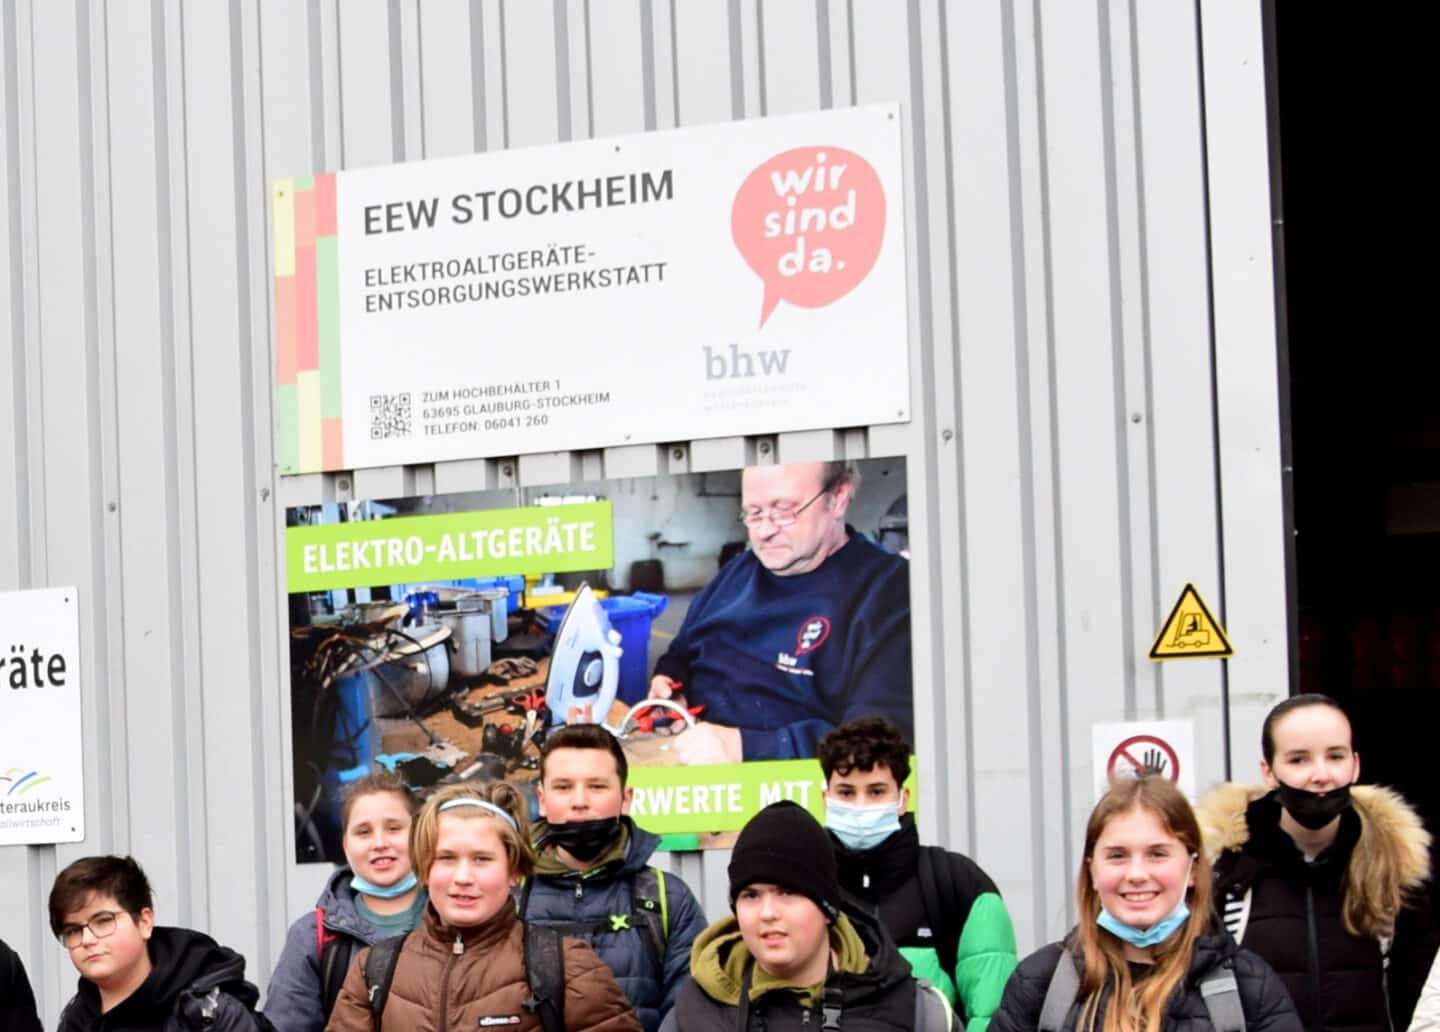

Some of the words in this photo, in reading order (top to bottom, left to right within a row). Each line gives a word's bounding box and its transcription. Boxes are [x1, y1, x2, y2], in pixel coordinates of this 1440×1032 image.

[770, 152, 847, 197] wir
[364, 198, 439, 235] EEW
[451, 169, 674, 225] STOCKHEIM
[764, 188, 856, 238] sind
[364, 243, 596, 288] ELEKTROALTGERÄTE-
[777, 235, 845, 277] da.
[365, 262, 668, 313] ENTSORGUNGSWERKSTATT
[702, 343, 792, 381] bhw
[422, 391, 450, 403] ZUM
[554, 379, 561, 391] 1
[422, 407, 460, 419] 63695
[463, 391, 610, 417] GLAUBURG-STOCKHEIM
[424, 421, 479, 436] TELEFON:
[484, 417, 521, 430] 06041
[526, 414, 549, 426] 260
[303, 516, 596, 573] ELEKTRO-ALTGERÄTE
[629, 783, 743, 817] RWERTE
